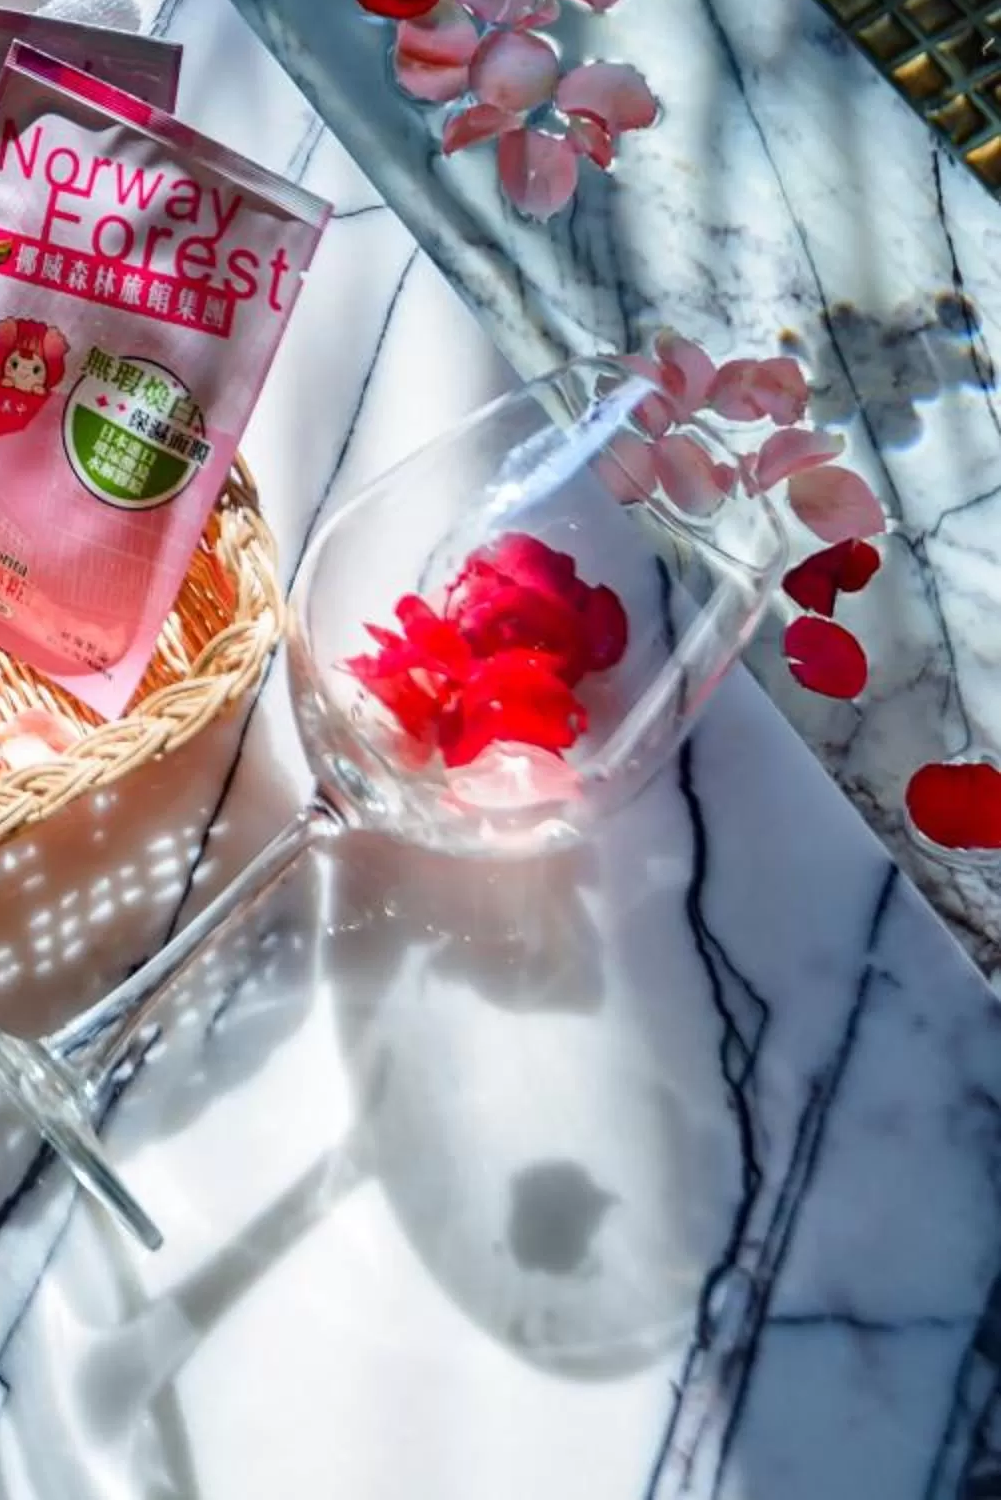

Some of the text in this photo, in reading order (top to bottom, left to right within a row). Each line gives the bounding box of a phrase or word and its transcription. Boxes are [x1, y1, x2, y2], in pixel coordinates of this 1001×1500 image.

[15, 243, 225, 329] 挪威森林旅館集團
[40, 182, 289, 311] Forest
